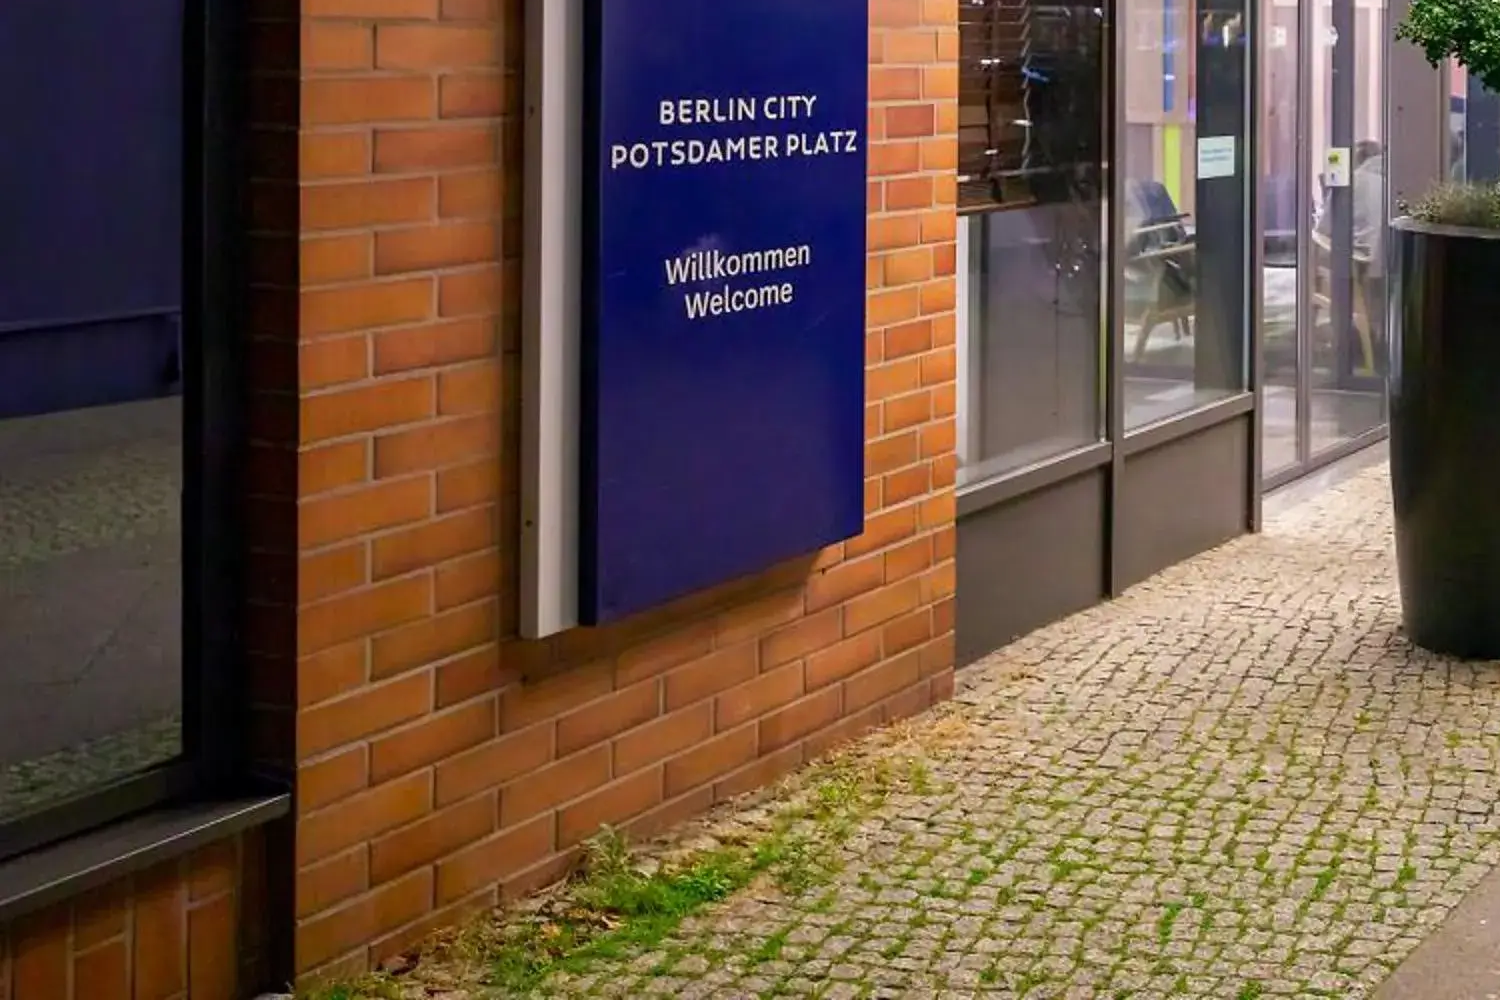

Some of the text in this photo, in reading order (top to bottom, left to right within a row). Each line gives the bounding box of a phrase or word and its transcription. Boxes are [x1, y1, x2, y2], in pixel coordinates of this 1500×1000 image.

[659, 95, 817, 125] BERLIN CITY
[611, 130, 857, 169] POTSDAMER PLATZ
[665, 244, 811, 285] Willkommen
[685, 282, 793, 319] Welcome
